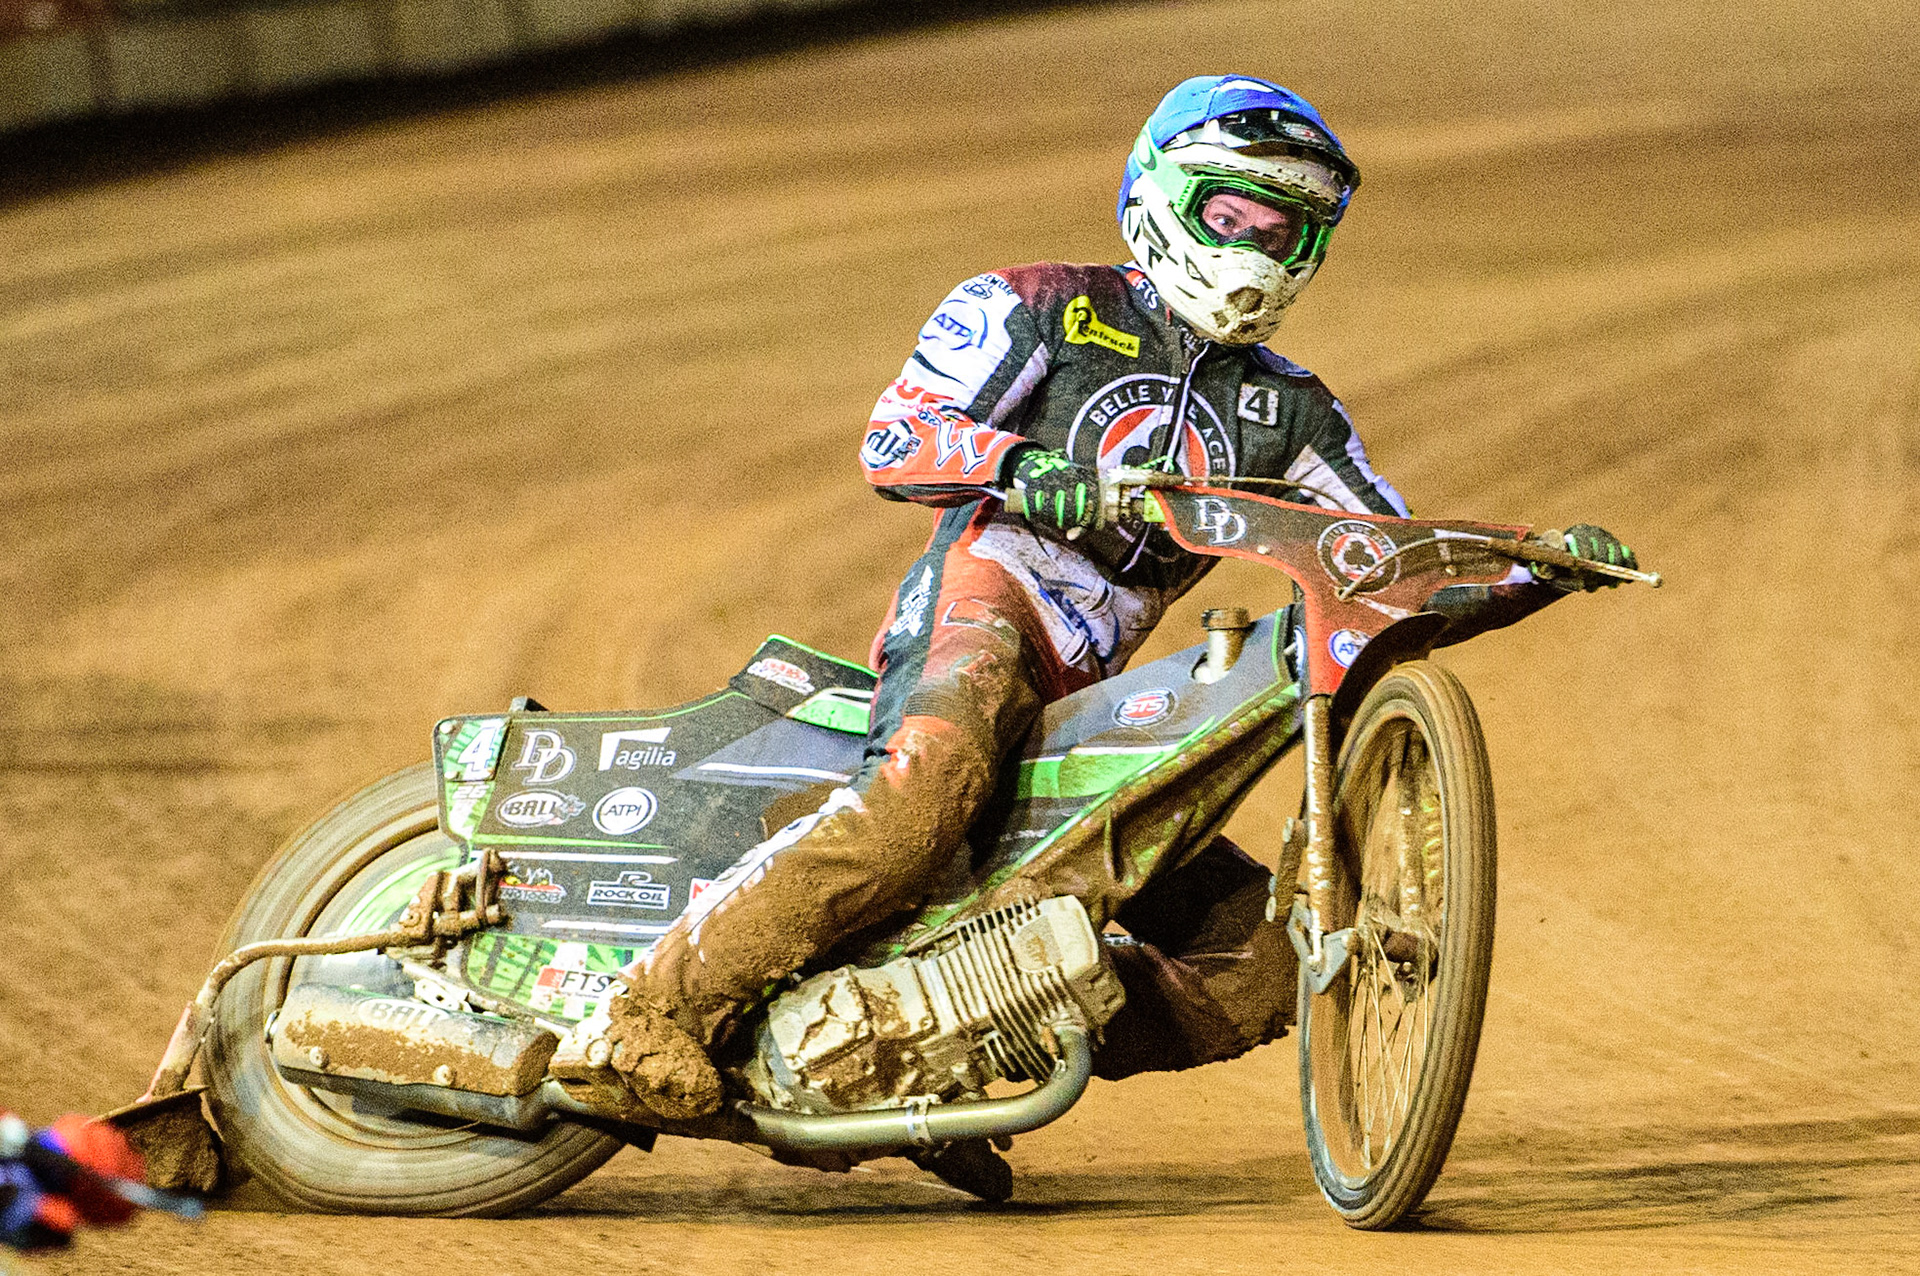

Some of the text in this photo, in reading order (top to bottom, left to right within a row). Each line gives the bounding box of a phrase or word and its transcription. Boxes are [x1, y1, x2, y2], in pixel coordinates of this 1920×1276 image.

[1135, 278, 1159, 310] FTS
[1088, 384, 1151, 428] BELLE
[1244, 388, 1272, 424] 4
[1123, 698, 1165, 715] STS
[456, 721, 500, 776] 4
[615, 747, 677, 771] agilia
[602, 803, 642, 817] ATPI
[592, 889, 664, 901] ROCK OIL
[560, 970, 611, 993] FTS
